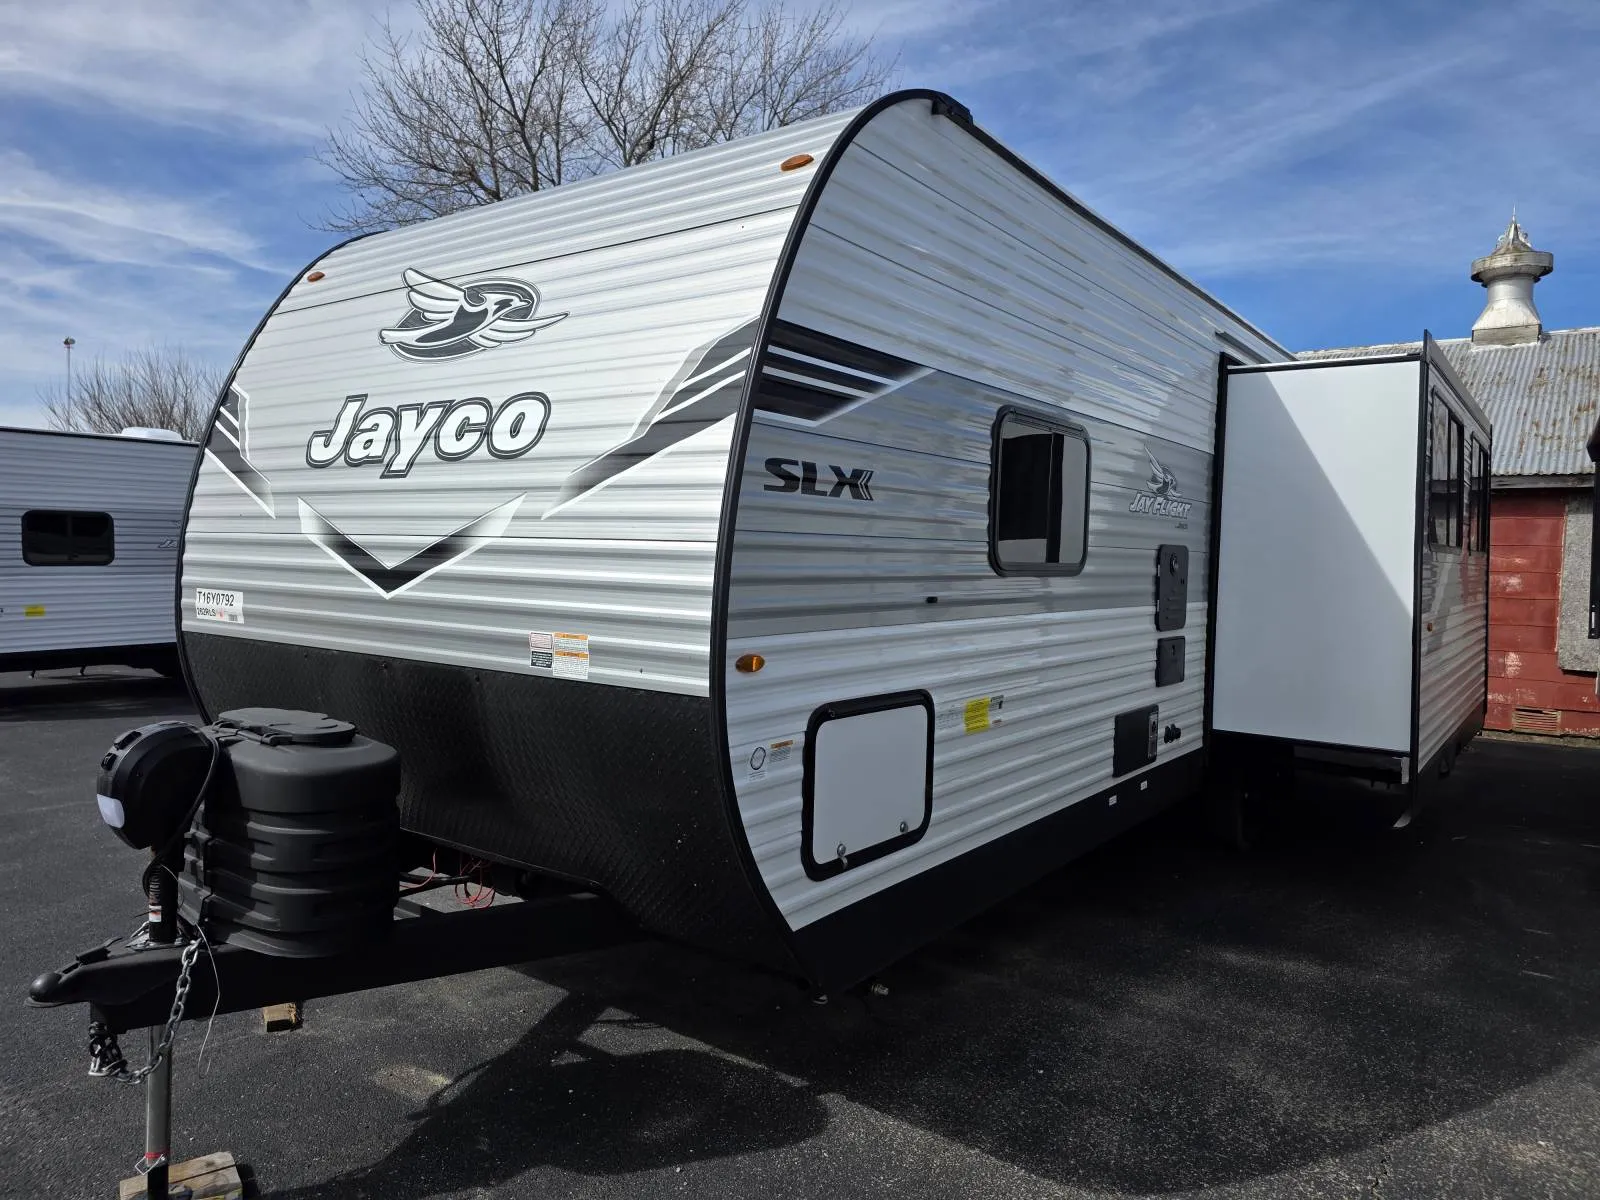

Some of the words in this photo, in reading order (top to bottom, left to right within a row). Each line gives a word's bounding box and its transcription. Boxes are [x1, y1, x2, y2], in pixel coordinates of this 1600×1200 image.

[305, 392, 552, 479] Jayco
[763, 457, 874, 501] SLX
[1152, 495, 1193, 520] FLIGHT
[197, 591, 235, 607] T16Y0792
